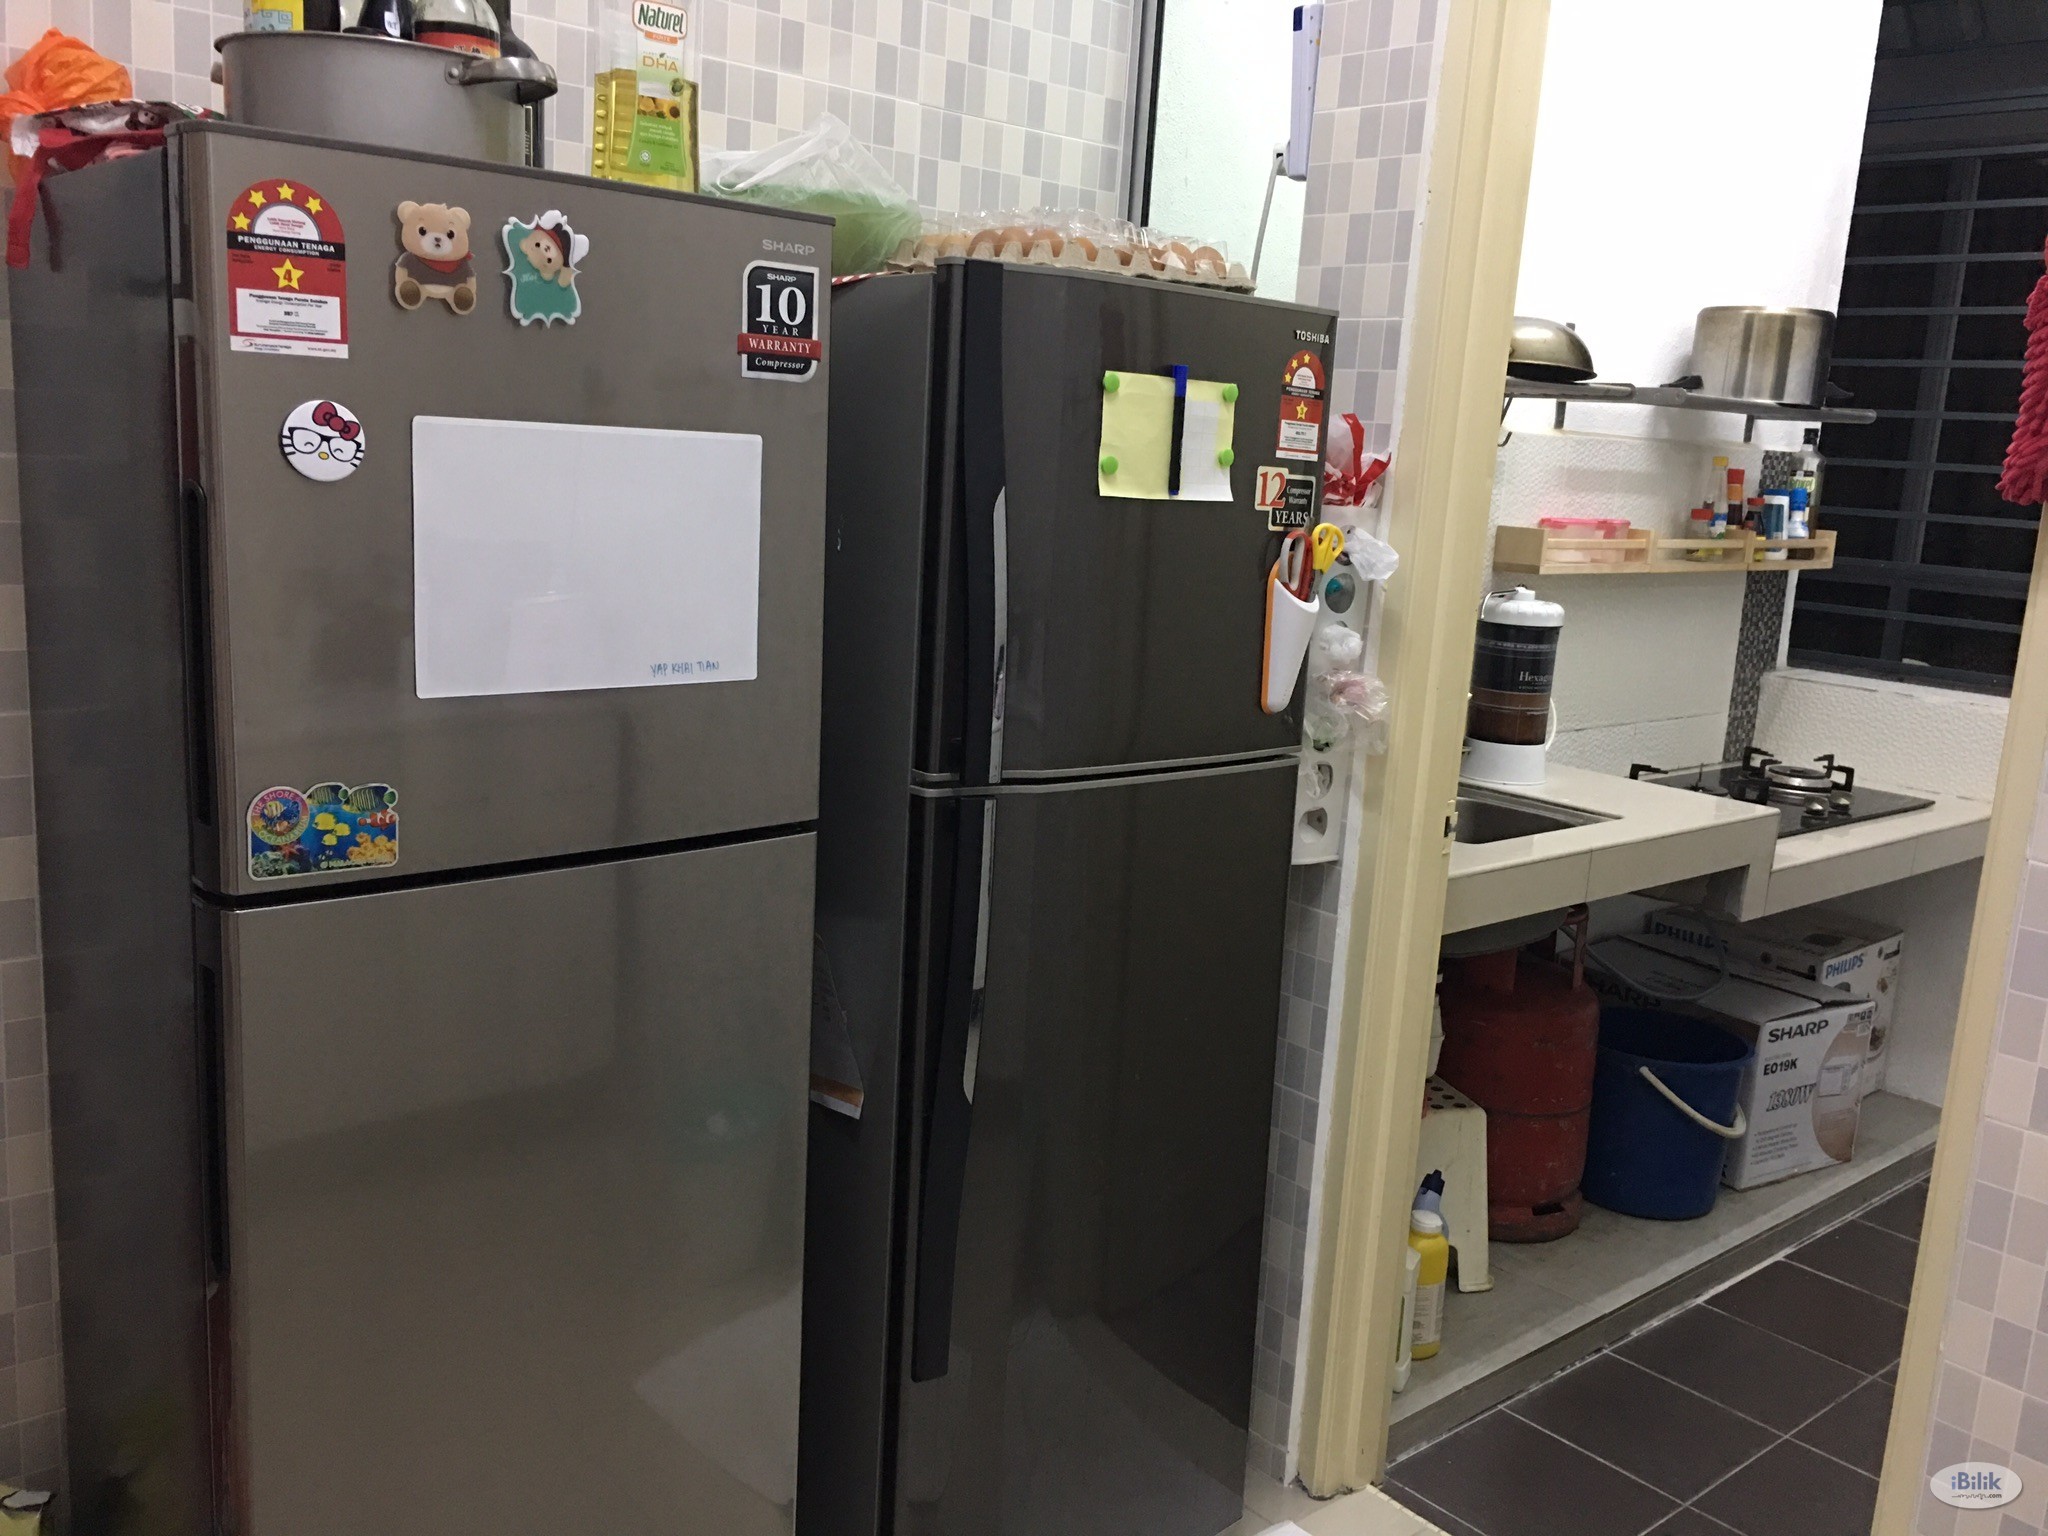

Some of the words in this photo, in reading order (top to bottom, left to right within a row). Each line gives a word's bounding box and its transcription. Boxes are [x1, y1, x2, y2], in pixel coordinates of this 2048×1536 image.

[637, 3, 684, 34] Naturel
[642, 55, 679, 73] DHA
[237, 235, 299, 248] PENGGUNAAN
[302, 242, 335, 253] TENAGA
[278, 247, 320, 256] CONSUMPTION
[762, 239, 816, 256] SHARP
[283, 269, 293, 283] 4
[766, 272, 797, 283] SHARP
[755, 284, 807, 326] 10
[762, 324, 800, 336] YEAR
[1295, 330, 1330, 344] TOSHIBA
[749, 337, 812, 354] WARRANTY
[755, 357, 805, 370] Compressor
[1257, 471, 1287, 508] 12
[1275, 510, 1309, 525] YEARS
[650, 663, 668, 678] YAP
[671, 662, 693, 675] KHAI
[252, 801, 265, 816] THE
[264, 790, 294, 803] SHORE
[258, 815, 308, 843] OCEANARIUM
[1825, 953, 1864, 979] PHILIPS
[1768, 1019, 1829, 1044] SHARP
